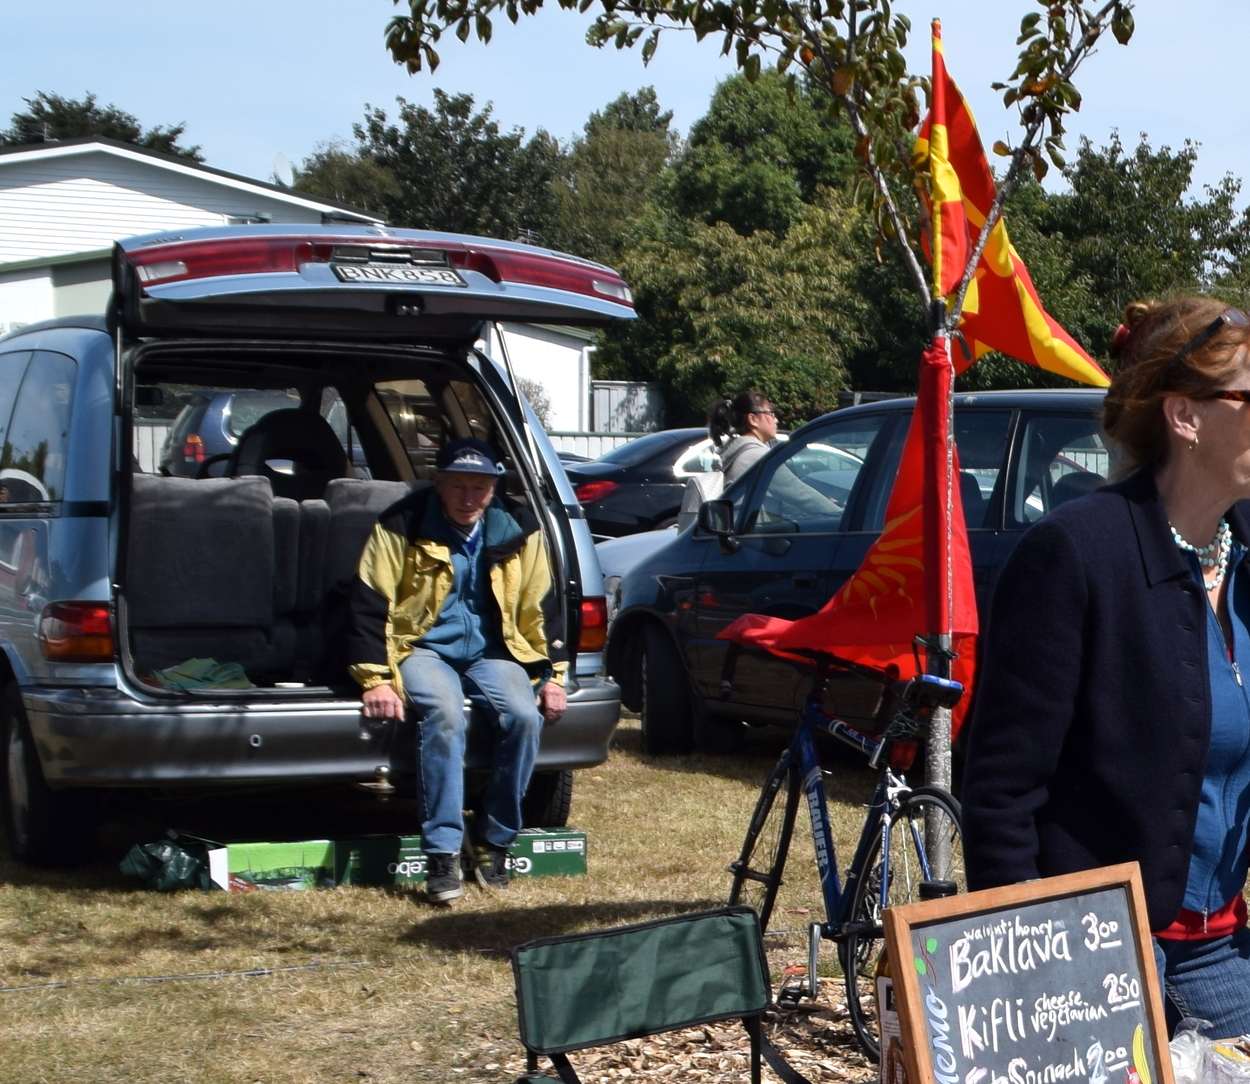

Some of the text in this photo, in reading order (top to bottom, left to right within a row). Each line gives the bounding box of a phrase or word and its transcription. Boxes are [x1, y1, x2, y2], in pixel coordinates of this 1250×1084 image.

[341, 267, 458, 283] BNK858
[1015, 915, 1053, 937] honey
[949, 927, 1072, 994] Baklava
[957, 997, 1026, 1060] Kifli
[1031, 1003, 1108, 1042] vegetarian
